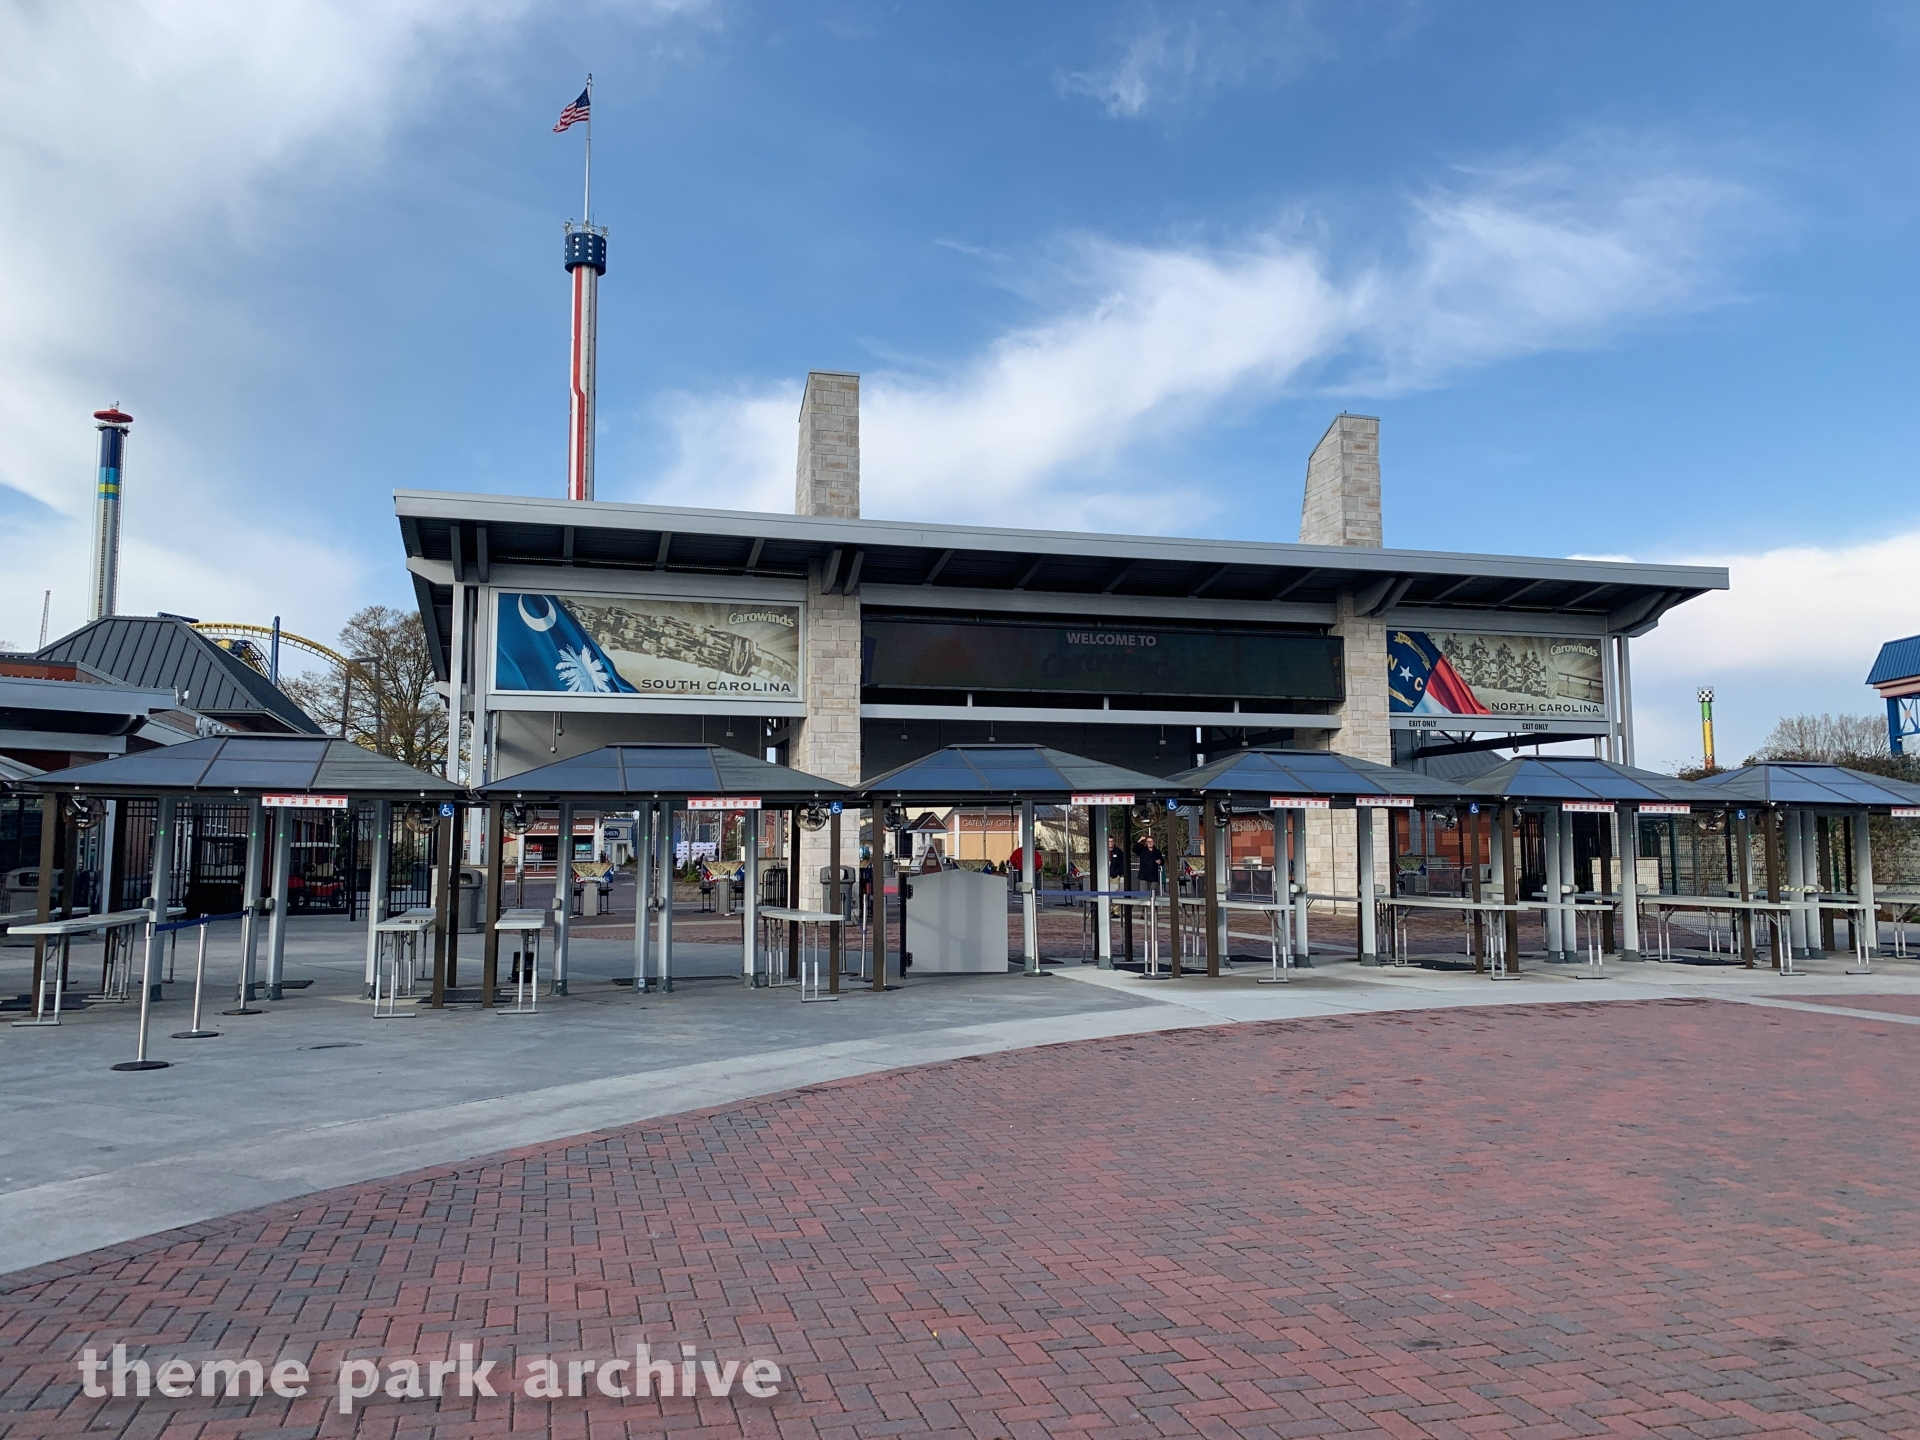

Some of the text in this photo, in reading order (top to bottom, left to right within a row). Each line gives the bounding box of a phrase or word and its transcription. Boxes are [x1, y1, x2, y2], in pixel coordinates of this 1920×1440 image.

[728, 611, 795, 628] Carowinds
[1066, 632, 1157, 647] WELCOME TO
[1550, 643, 1599, 657] Carowinds
[641, 679, 791, 692] SOUTH CAROLINA
[1414, 677, 1424, 691] C
[1491, 702, 1600, 713] NORTH CAROLINA
[1422, 720, 1437, 728] ONLY
[962, 819, 1016, 827] GATEWAY GIFTS
[1231, 819, 1274, 832] RESTROOMS
